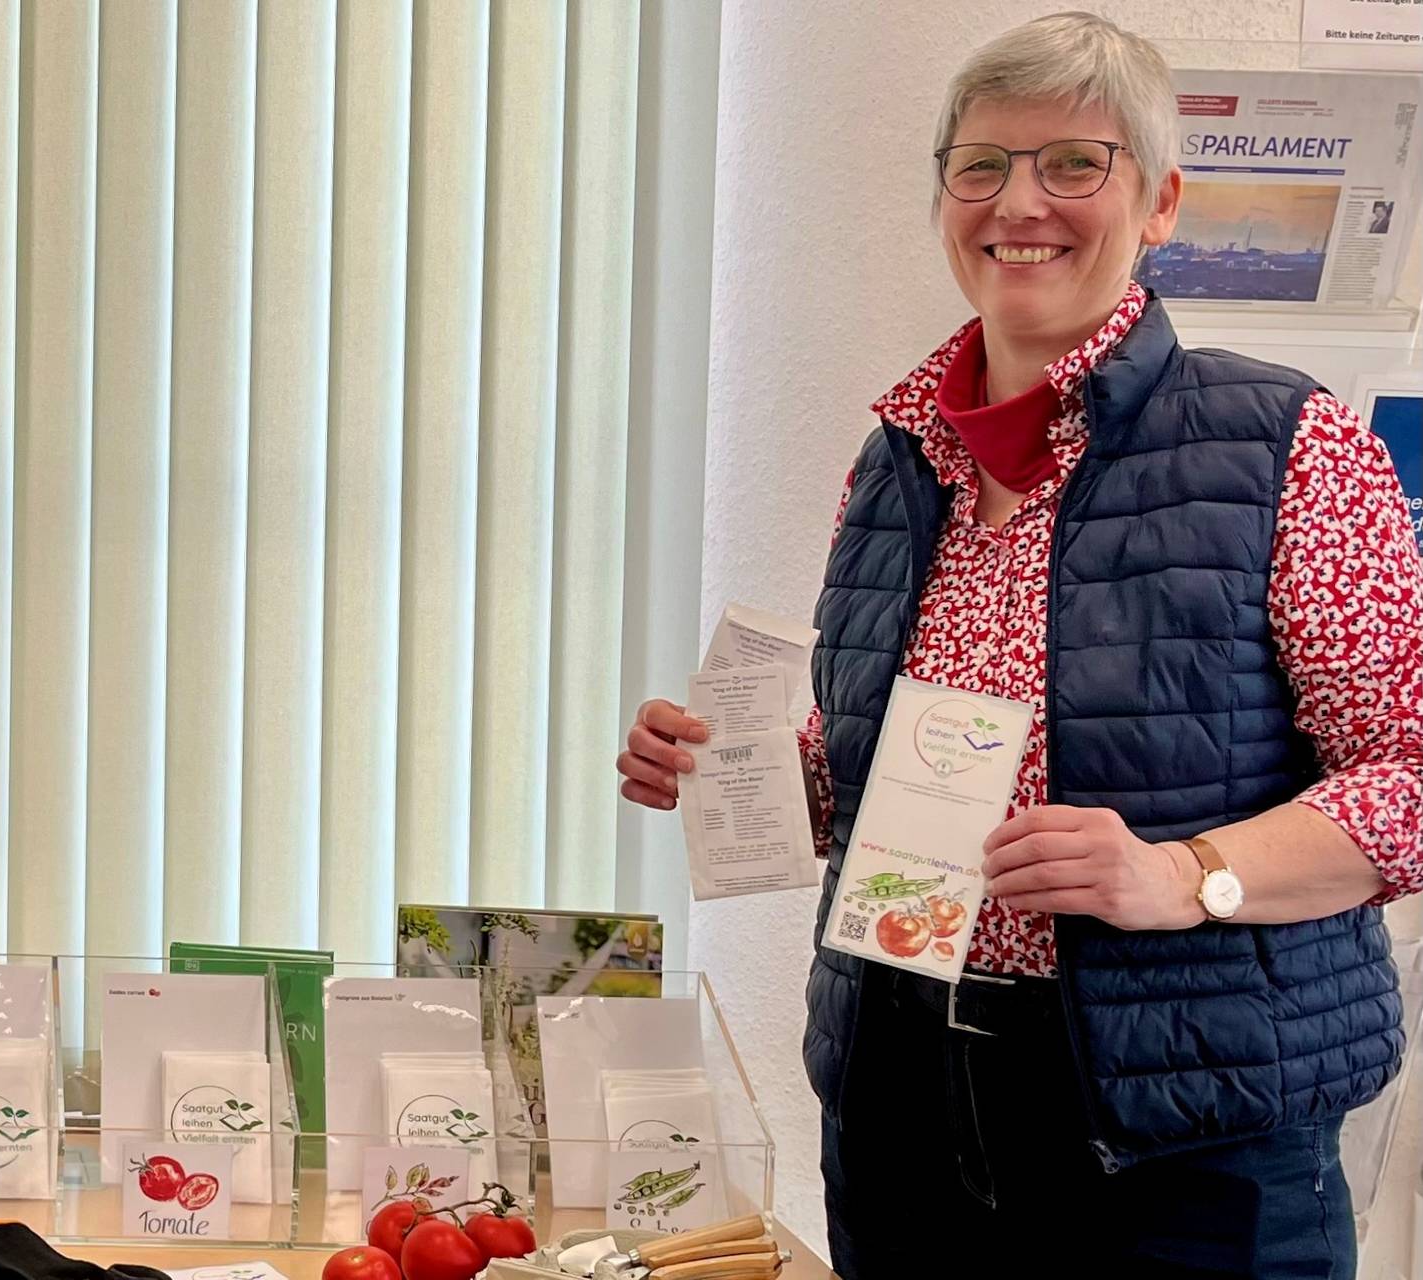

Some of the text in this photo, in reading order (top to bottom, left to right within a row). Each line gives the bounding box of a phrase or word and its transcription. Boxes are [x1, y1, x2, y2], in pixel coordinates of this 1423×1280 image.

[1325, 29, 1420, 42] Bitte keine Zeitungen
[929, 712, 969, 729] Saatgut
[925, 726, 955, 740] leihen
[922, 741, 992, 763] Vielfalt ernten
[861, 841, 979, 878] www.saatgutleihen.de
[182, 1103, 223, 1115] Saatgut
[182, 1119, 213, 1128] leihen
[407, 1113, 450, 1124] Saatgut
[182, 1133, 256, 1145] Vielfalt ernten
[408, 1128, 440, 1137] leihen
[138, 1209, 210, 1236] Tomate
